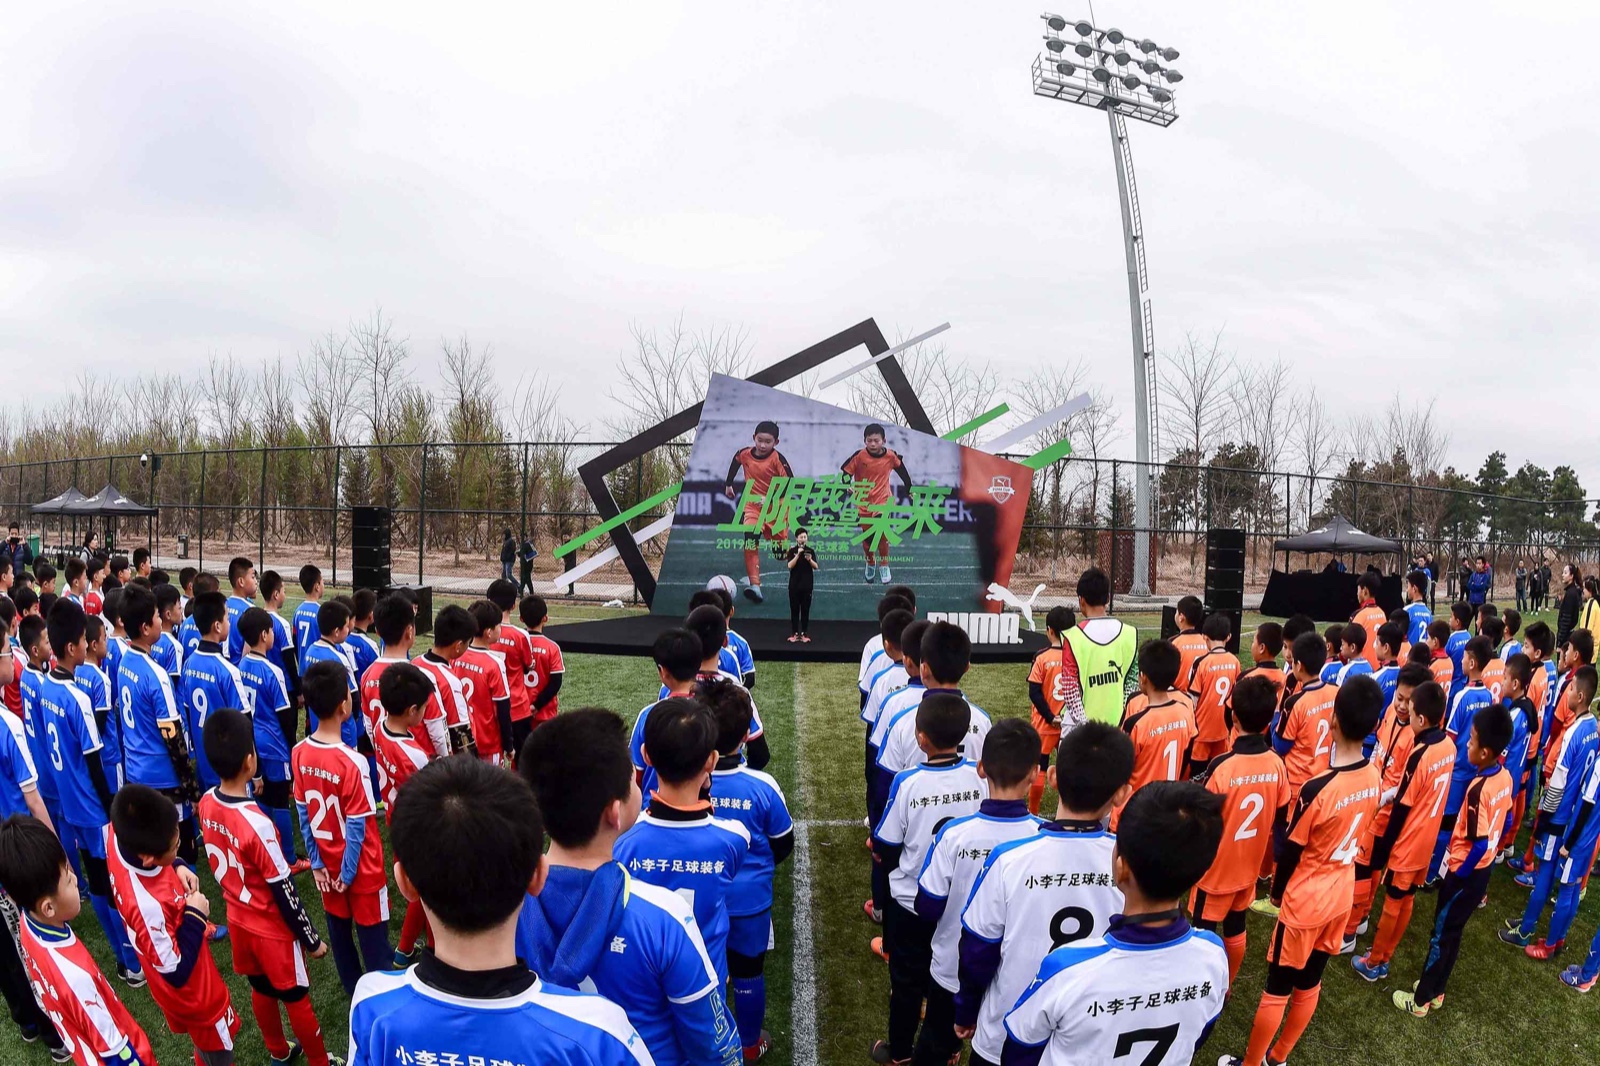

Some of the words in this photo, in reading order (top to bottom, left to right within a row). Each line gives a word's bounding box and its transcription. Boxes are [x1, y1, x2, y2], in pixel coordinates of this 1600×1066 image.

[716, 476, 815, 537] 上限
[850, 479, 953, 552] 未来
[299, 621, 310, 648] 7
[121, 686, 136, 730] 8
[192, 687, 208, 728] 9
[1215, 676, 1231, 707] 9
[47, 722, 64, 771] 3
[1315, 718, 1330, 758] 2
[1163, 739, 1178, 781] 1
[305, 789, 347, 841] 21
[909, 789, 981, 809] 小李子足球装备
[1430, 771, 1450, 818] 7
[1234, 792, 1265, 842] 2
[1329, 812, 1364, 865] 4
[629, 858, 725, 875] 小李子足球装备
[610, 935, 628, 955] 备
[1087, 980, 1212, 1018] 小李子足球装备
[1112, 1023, 1180, 1066] 7
